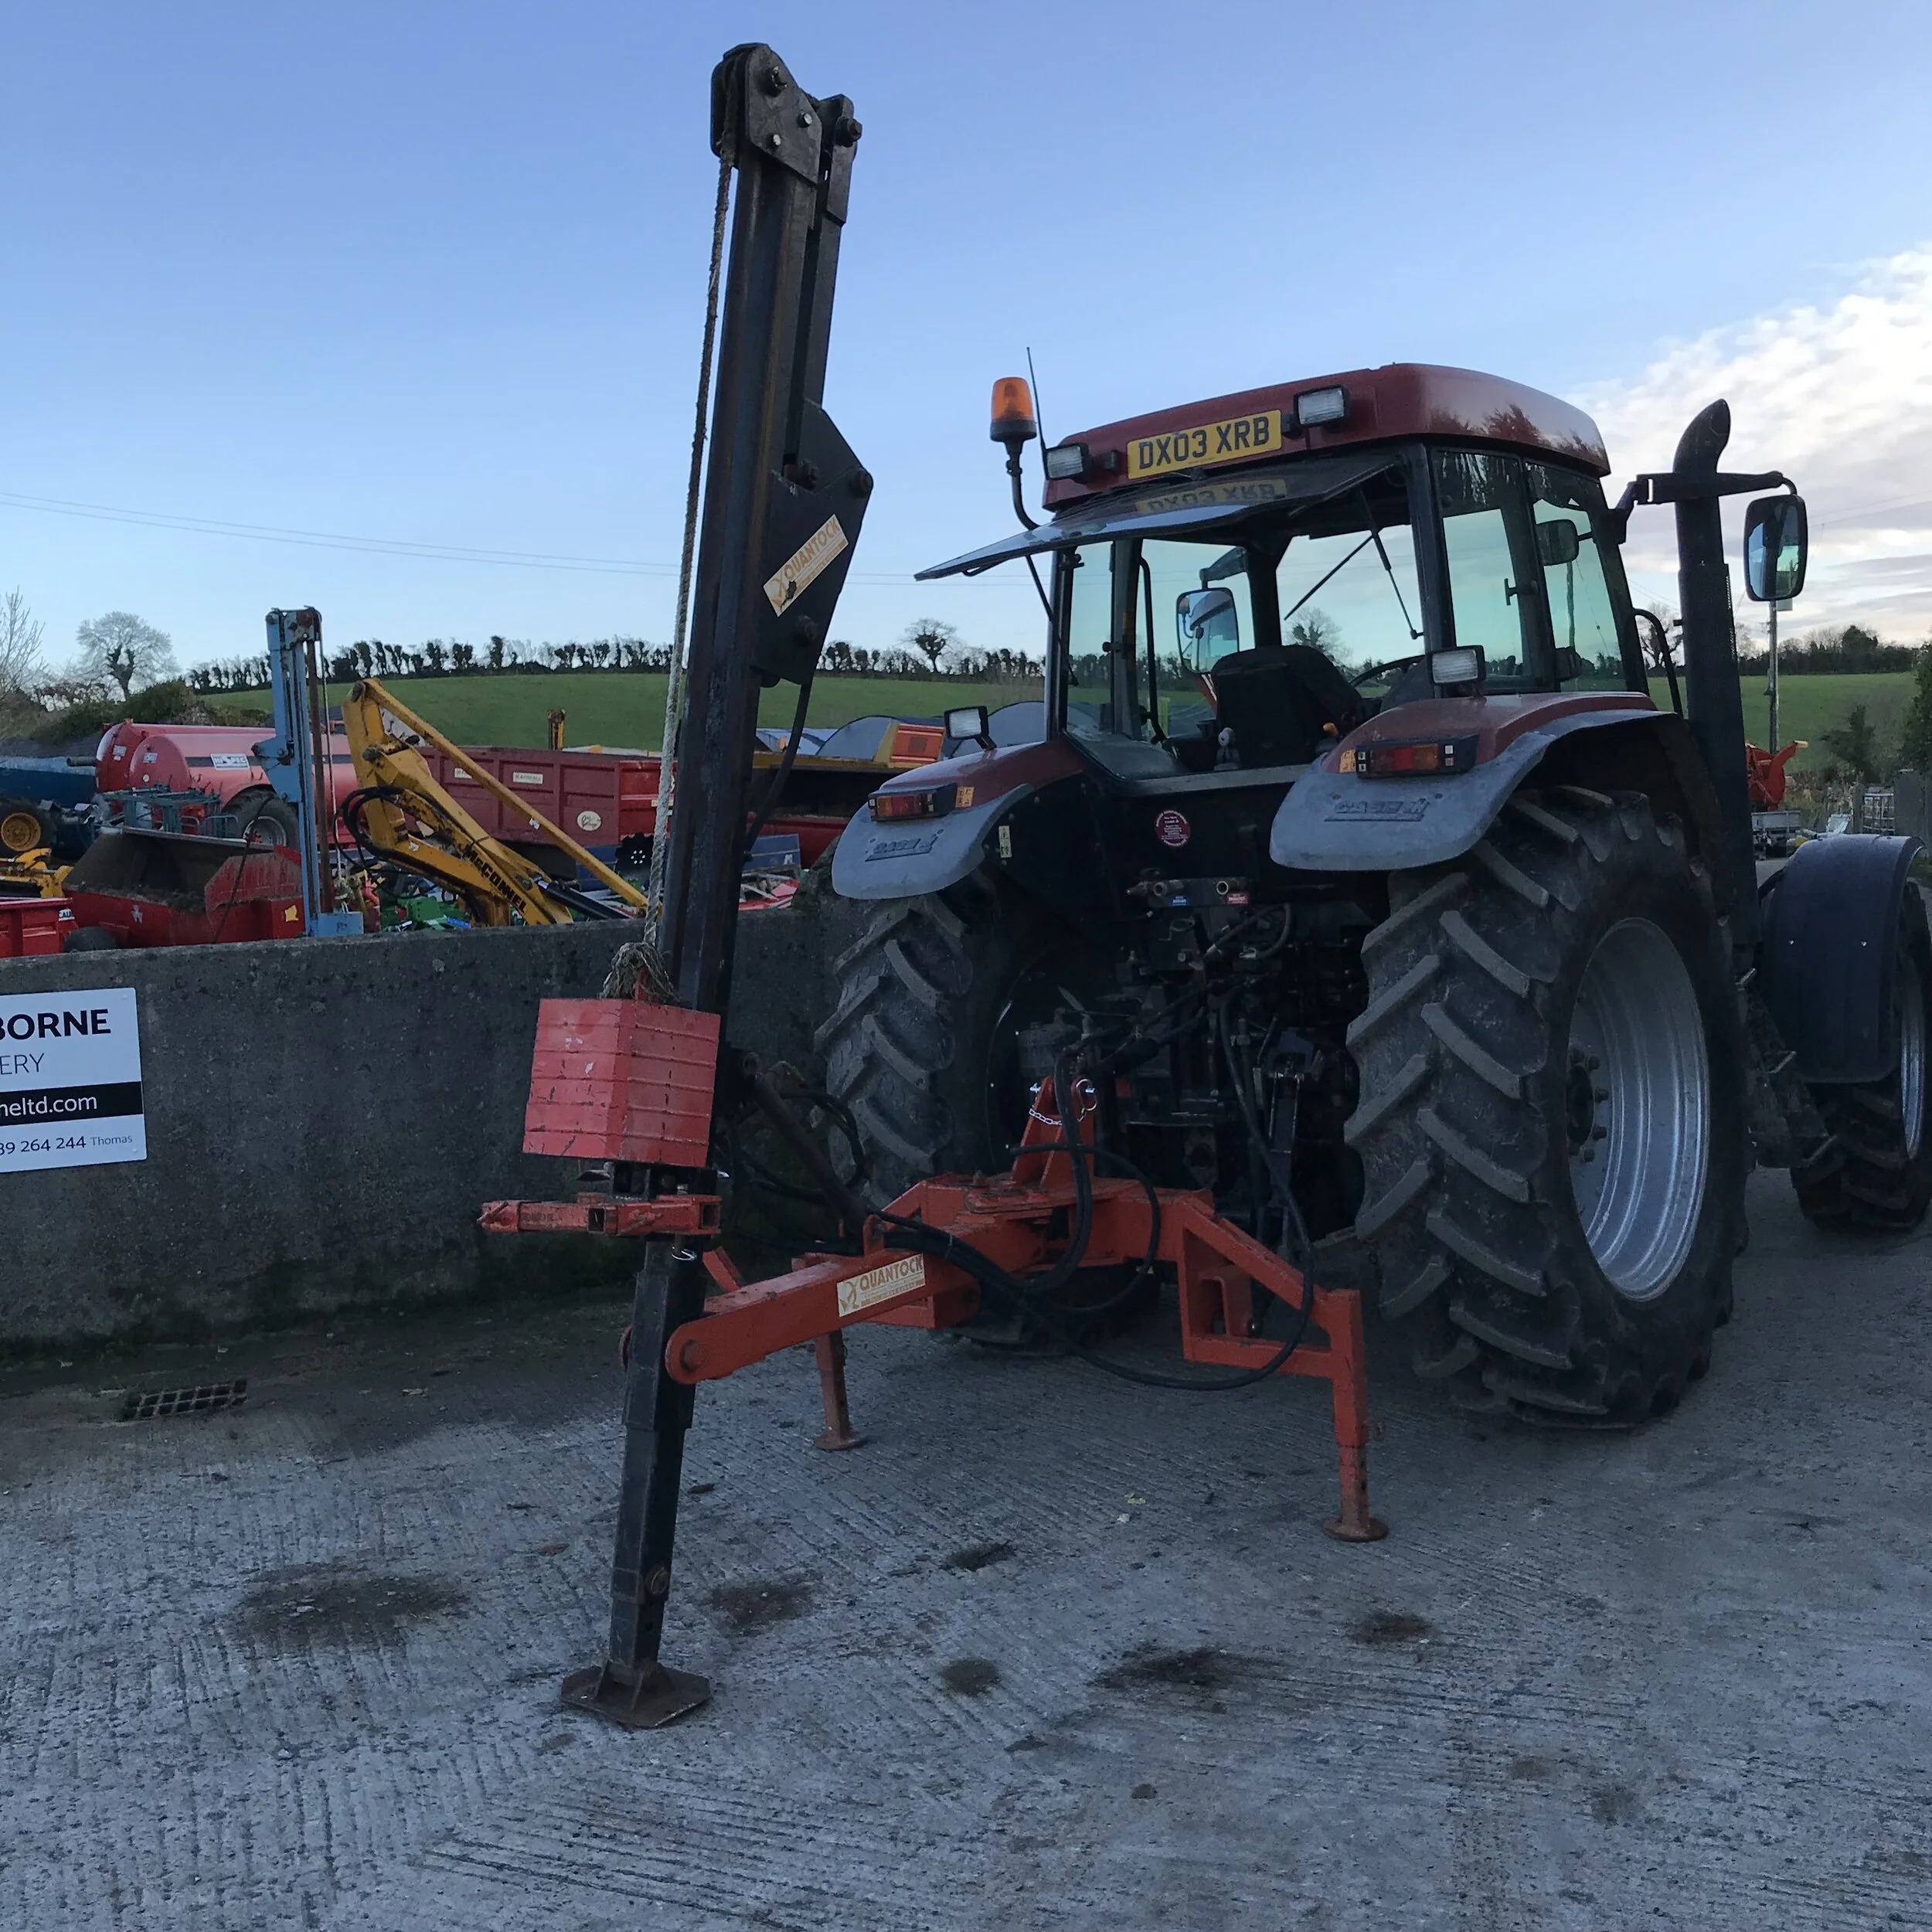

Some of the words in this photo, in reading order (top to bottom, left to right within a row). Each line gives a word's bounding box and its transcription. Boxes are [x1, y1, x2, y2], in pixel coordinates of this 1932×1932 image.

[1139, 430, 1207, 469] DX03
[1216, 417, 1270, 454] XRB
[784, 517, 840, 579] QUANTOCK
[0, 1053, 44, 1075] ERY
[20, 1138, 51, 1151] 264
[56, 1136, 87, 1150] 244
[90, 1136, 133, 1145] Thomas
[859, 1255, 923, 1291] QUANTOCK
